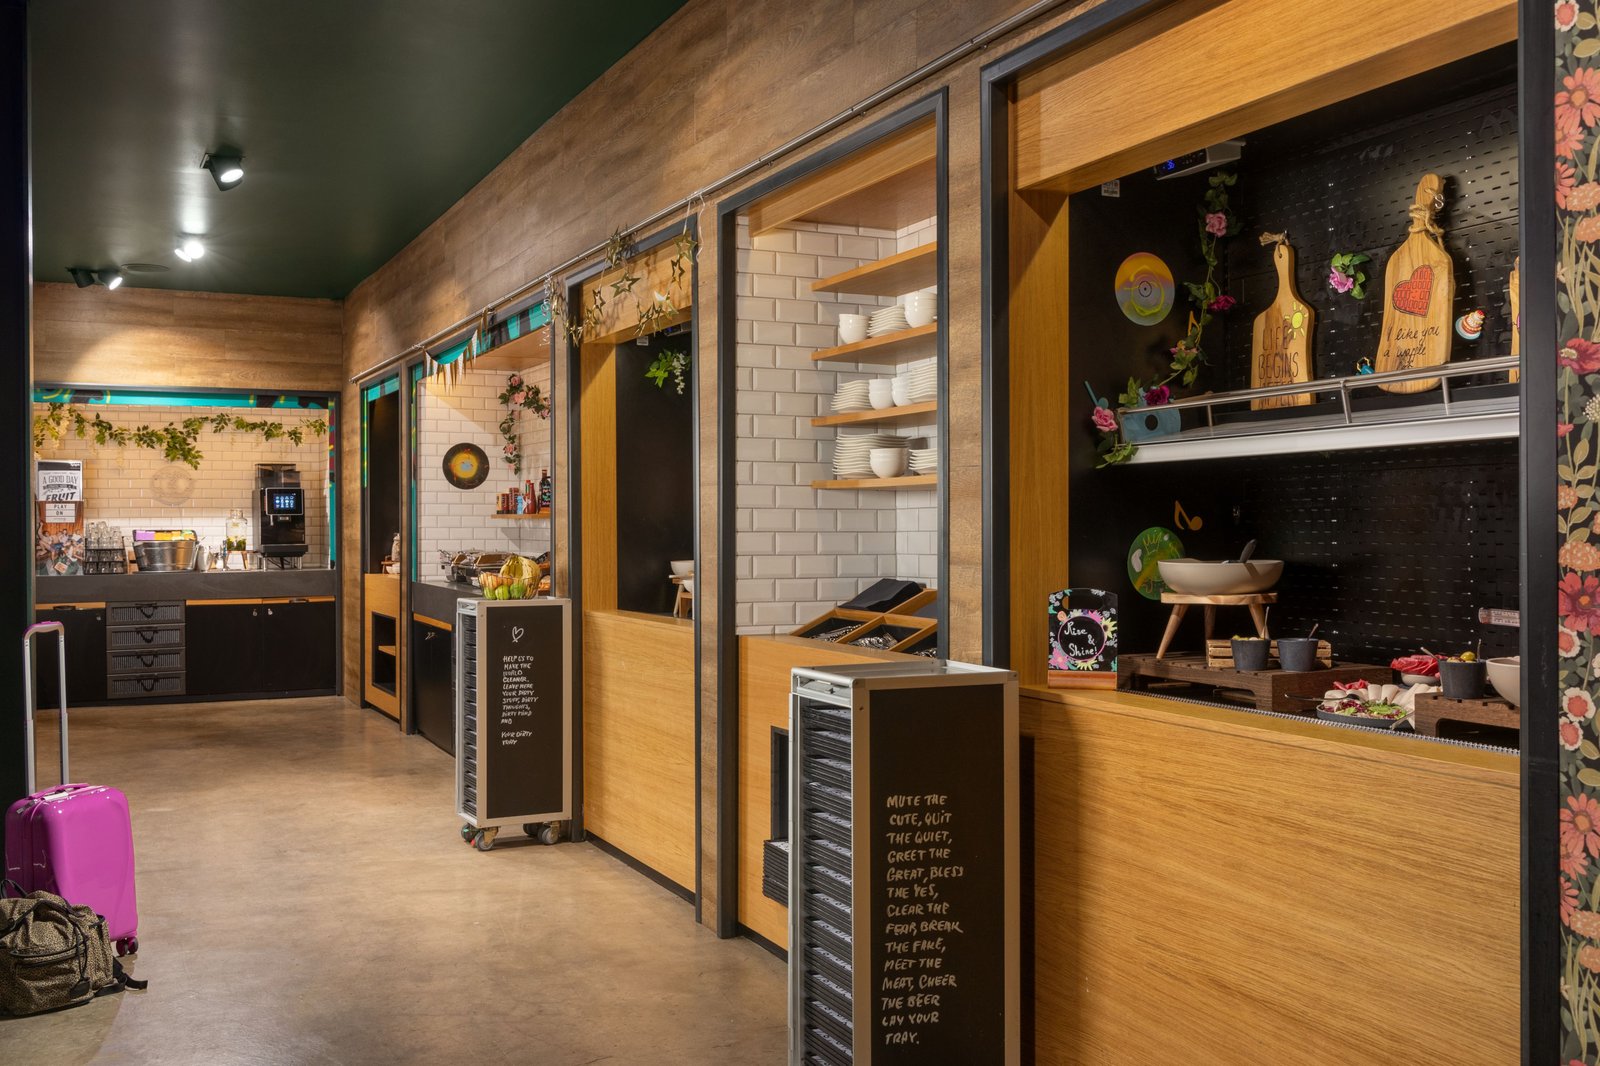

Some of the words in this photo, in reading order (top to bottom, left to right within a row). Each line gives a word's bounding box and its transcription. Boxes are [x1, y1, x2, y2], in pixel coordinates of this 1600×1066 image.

[1262, 326, 1289, 351] LIFE
[1395, 328, 1418, 340] like
[1421, 326, 1440, 348] you
[1383, 349, 1390, 357] a
[1258, 352, 1299, 379] BEGINS
[43, 476, 47, 484] A
[48, 475, 65, 484] GOOD
[65, 475, 78, 484] DAY
[46, 492, 76, 501] FRUIT
[1064, 621, 1088, 635] Rise
[1087, 634, 1095, 646] &
[1068, 643, 1098, 657] Shine!
[501, 731, 516, 739] YOUR
[886, 795, 922, 809] MUTE
[923, 793, 948, 806] THE
[889, 812, 923, 827] CUTE,
[885, 832, 913, 845] THE
[914, 830, 953, 845] QUIET,
[887, 849, 928, 864] GREET
[929, 847, 952, 859] THE
[886, 866, 929, 884] GREAT,
[929, 865, 965, 880] BLESS
[886, 887, 910, 899] THE
[913, 883, 940, 901] YES,
[887, 903, 925, 918] CLEAR
[926, 901, 950, 915] THE
[919, 919, 965, 934] BREAK
[884, 941, 911, 954] THE
[912, 937, 947, 954] FAKE,
[883, 959, 917, 973] MEET
[918, 957, 943, 969] THE
[881, 976, 915, 992] MEAT,
[918, 973, 958, 990] CHEER
[881, 996, 905, 1011] THE
[907, 992, 941, 1008] BEER
[881, 1015, 905, 1027] LAY
[908, 1011, 940, 1025] YOUR
[885, 1031, 920, 1045] TRAY.
